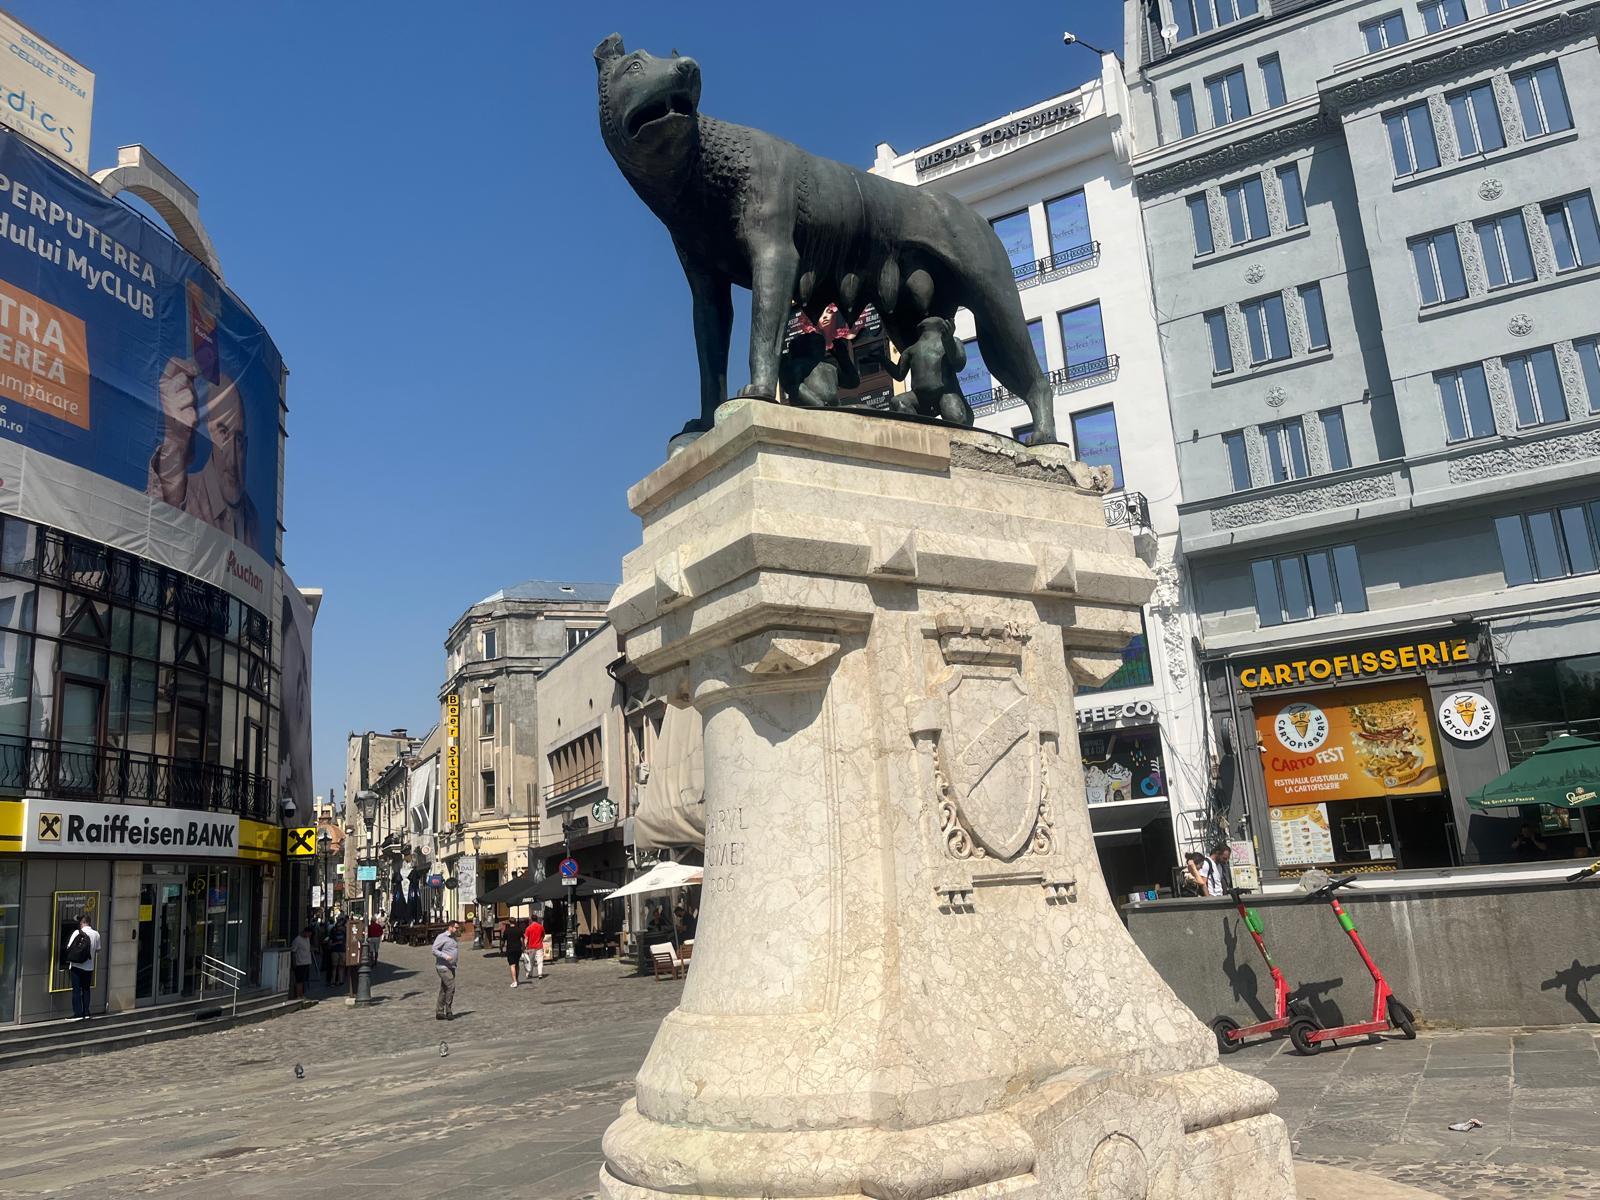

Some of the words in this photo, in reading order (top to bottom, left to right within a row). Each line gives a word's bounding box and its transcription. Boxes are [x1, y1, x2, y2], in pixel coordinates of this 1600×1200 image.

[9, 44, 55, 77] CELULE
[20, 33, 59, 64] BANCA
[62, 62, 77, 77] DE
[0, 85, 73, 152] dics
[916, 141, 974, 172] MEDIA
[67, 248, 155, 319] MyCLUB
[0, 293, 66, 354] TRA
[227, 549, 264, 593] Auchan
[1240, 639, 1470, 689] CARTOFISSERIE
[449, 695, 457, 735] Beer
[1278, 714, 1326, 749] CARTOFISSERIE
[1443, 704, 1491, 737] CARTOFISSERIE
[1271, 756, 1316, 772] CARTO
[1315, 746, 1345, 764] FEST
[449, 746, 457, 821] Station
[1274, 776, 1310, 787] FESTIVALUL
[1309, 773, 1349, 784] GUSTURILOR
[1284, 784, 1293, 794] LA
[1293, 782, 1341, 793] CARTOFISSERIE
[67, 814, 185, 846] Raiffeisen
[186, 821, 236, 848] BANK
